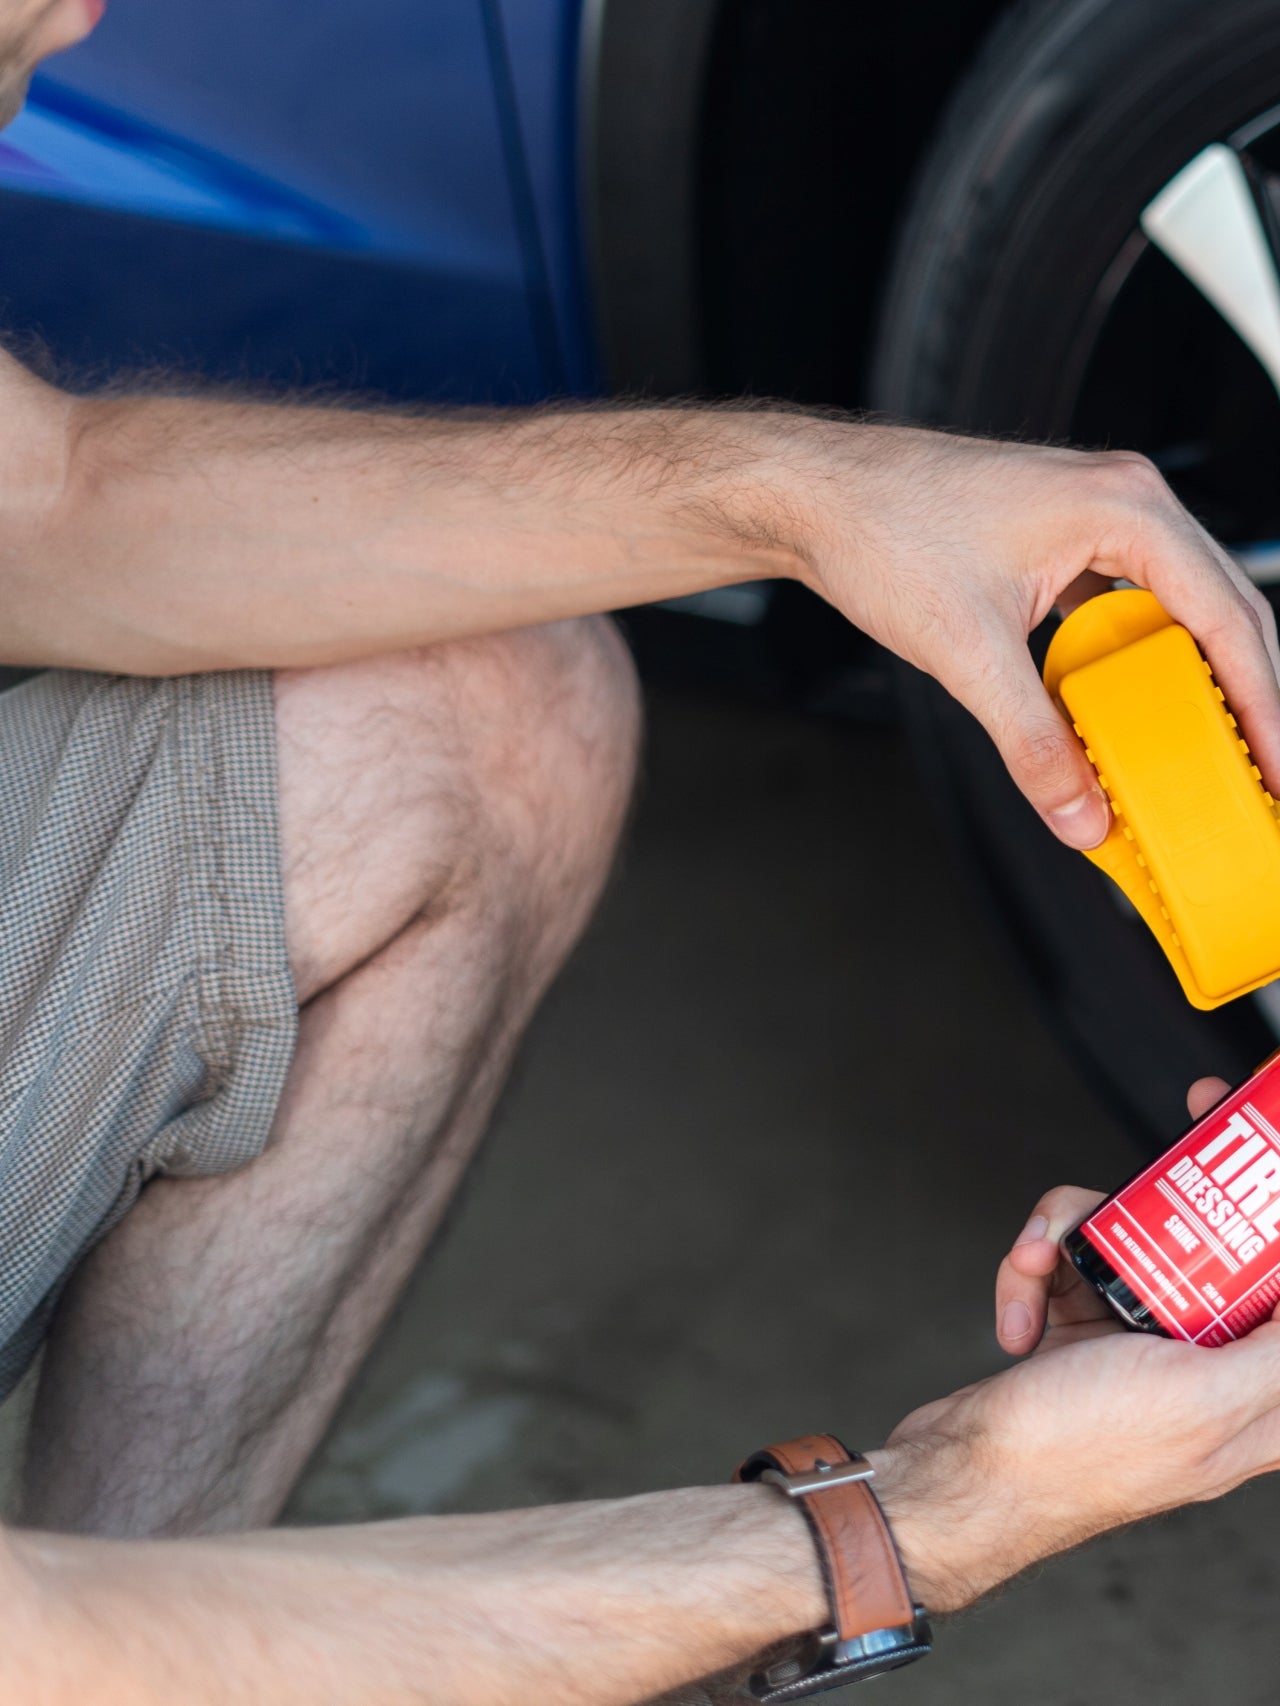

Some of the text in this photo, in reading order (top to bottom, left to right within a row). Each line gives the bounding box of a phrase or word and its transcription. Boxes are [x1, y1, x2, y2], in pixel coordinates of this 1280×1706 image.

[1163, 1214, 1201, 1254] SHINE
[1166, 1155, 1266, 1264] DRESSING
[1110, 1221, 1190, 1311] YOUR DETAILING ADDICTION
